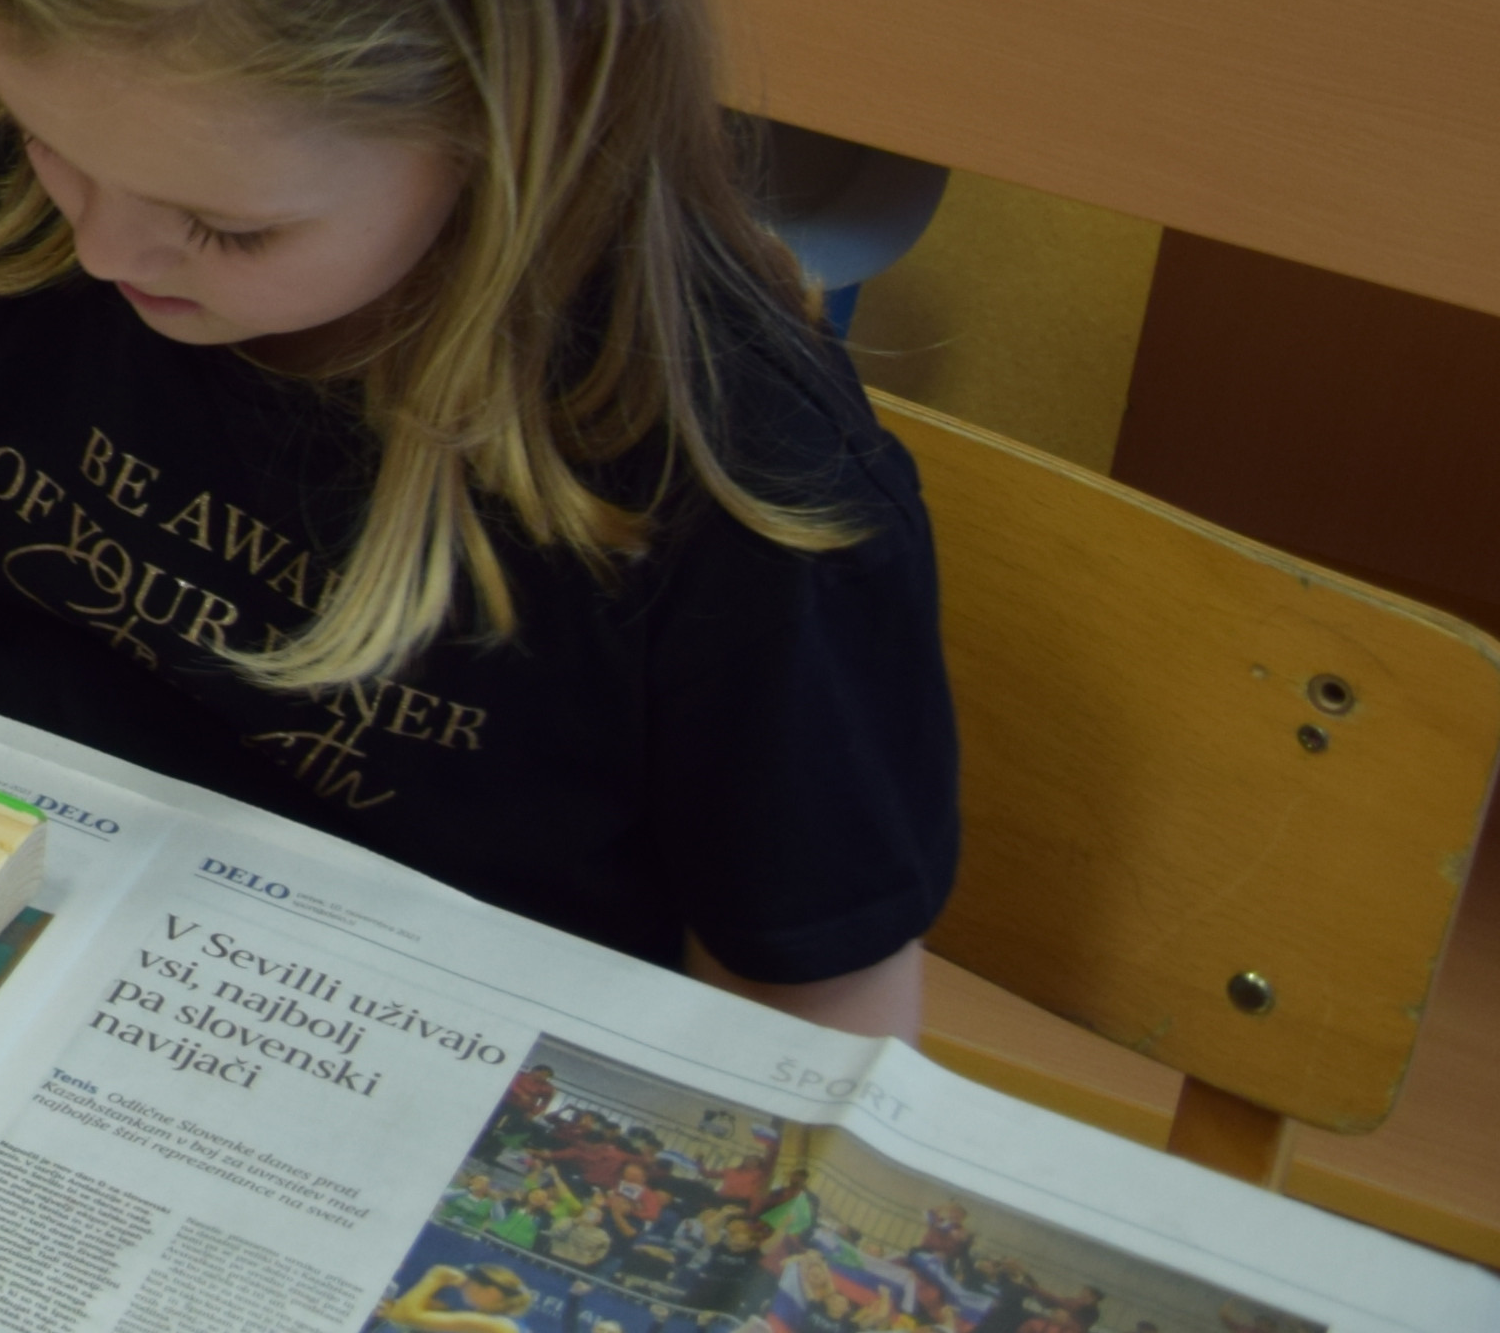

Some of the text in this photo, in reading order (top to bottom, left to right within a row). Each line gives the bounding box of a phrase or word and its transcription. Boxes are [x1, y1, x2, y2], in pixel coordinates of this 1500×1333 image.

[63, 502, 242, 654] YOUR
[78, 426, 348, 618] BE AWAR
[31, 792, 122, 835] DELO
[198, 856, 291, 900] DELO
[87, 1010, 264, 1092] navijači
[104, 977, 383, 1100] pa slovenski
[138, 948, 366, 1057] vsi, najbolj
[164, 912, 507, 1068] V Sevilli uživajo
[40, 1081, 182, 1142] Kazahstankam
[189, 1137, 219, 1162] boj
[220, 1153, 245, 1170] za
[245, 1158, 327, 1203] uvrstitev
[327, 1193, 372, 1220] med
[51, 1066, 362, 1201] Tenis Odlične Slovenke danes proti
[766, 1046, 914, 1127] ŠPORT
[32, 1093, 356, 1231] najboljše štiri reprezentance na svetu
